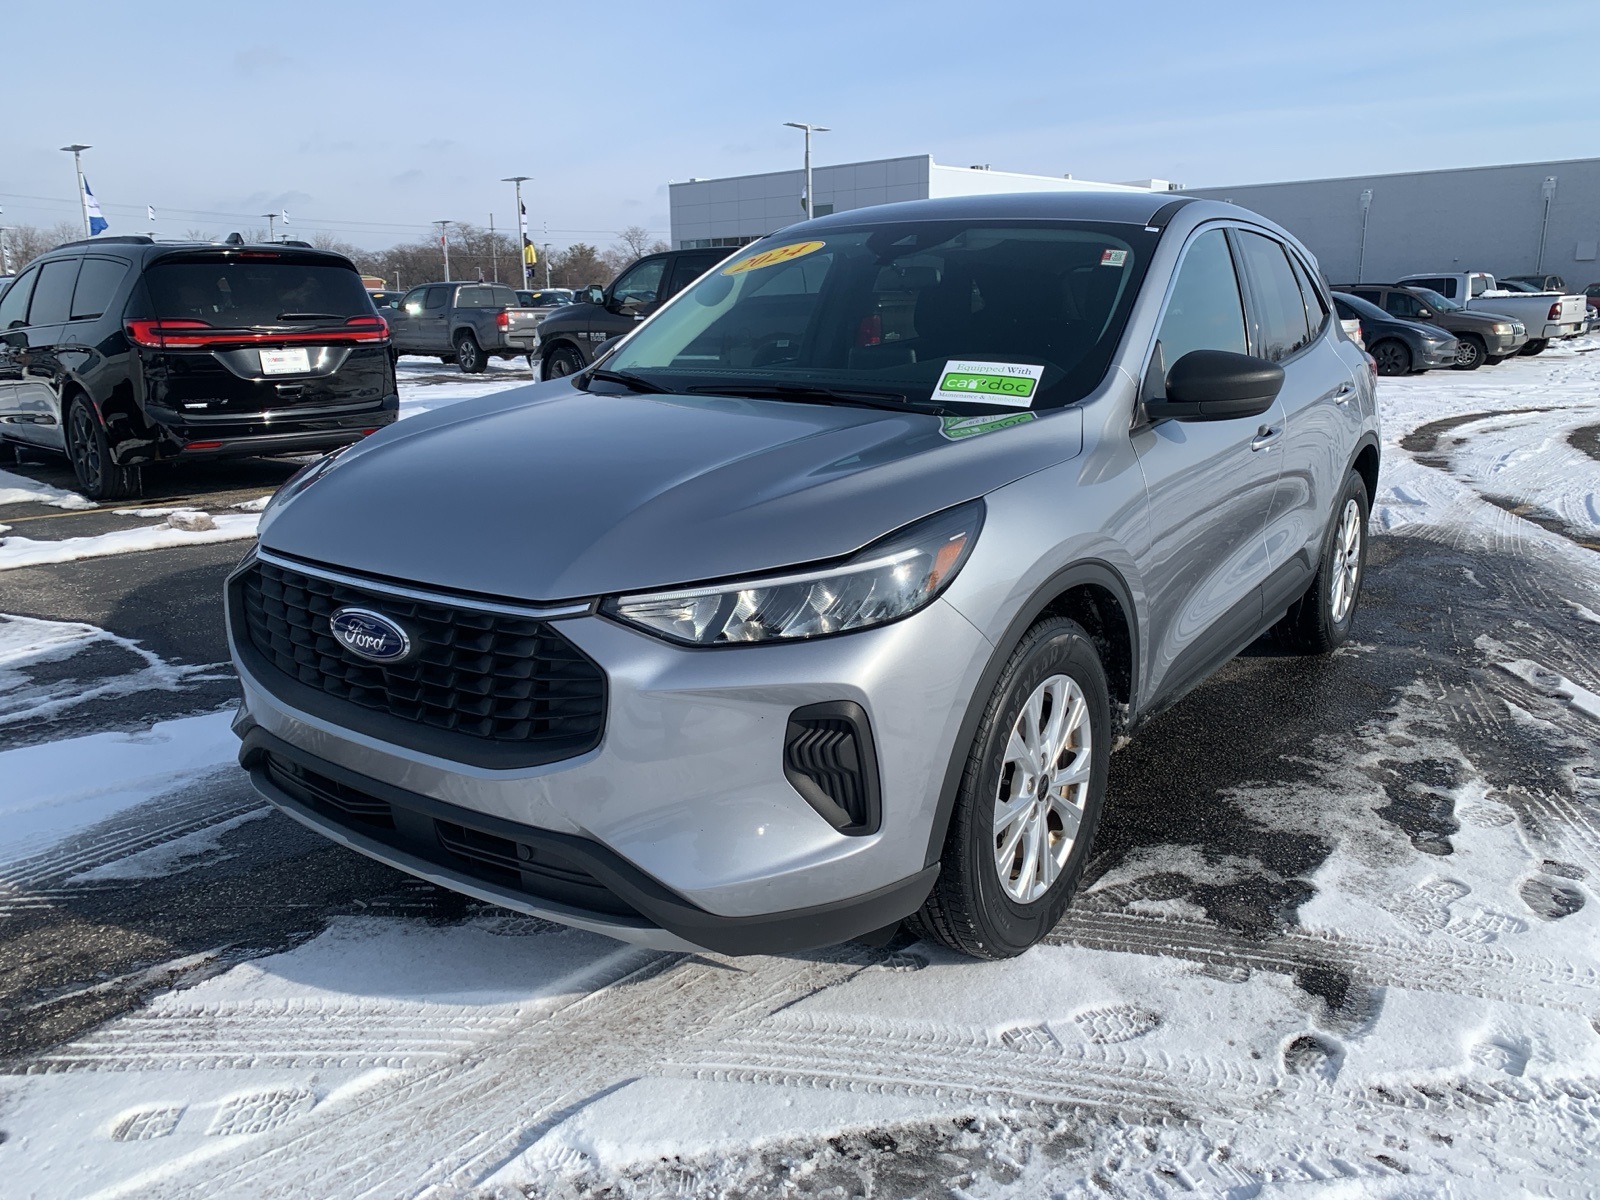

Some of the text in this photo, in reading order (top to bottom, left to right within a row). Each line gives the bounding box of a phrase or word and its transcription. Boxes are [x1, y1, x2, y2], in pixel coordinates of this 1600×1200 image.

[731, 242, 813, 273] 2024
[956, 363, 1032, 375] Equipped With
[988, 378, 1027, 393] doc
[937, 392, 978, 400] Maintenance
[987, 395, 1029, 405] Membership
[344, 618, 387, 652] Ford
